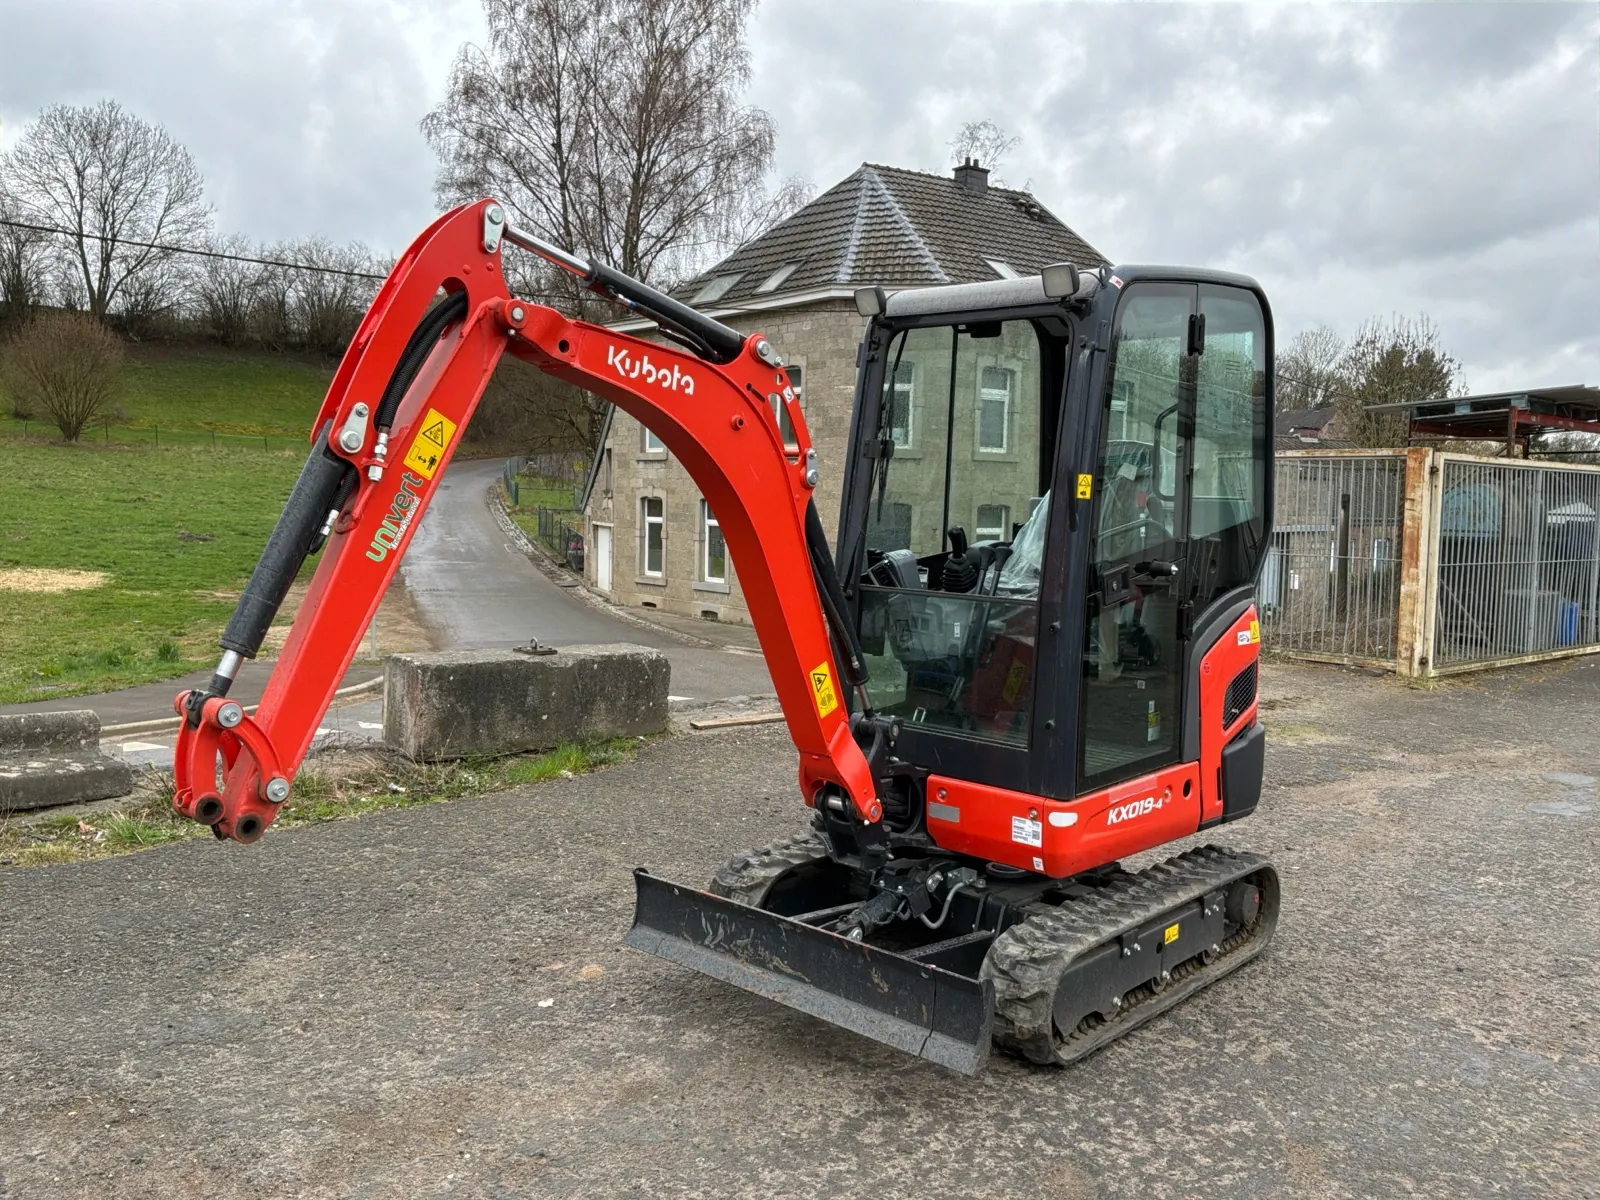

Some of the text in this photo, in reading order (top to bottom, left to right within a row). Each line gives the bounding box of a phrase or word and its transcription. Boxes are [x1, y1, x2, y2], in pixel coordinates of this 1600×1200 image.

[607, 344, 695, 396] Kubota
[365, 471, 424, 562] univert
[1106, 796, 1163, 826] KX019-4
